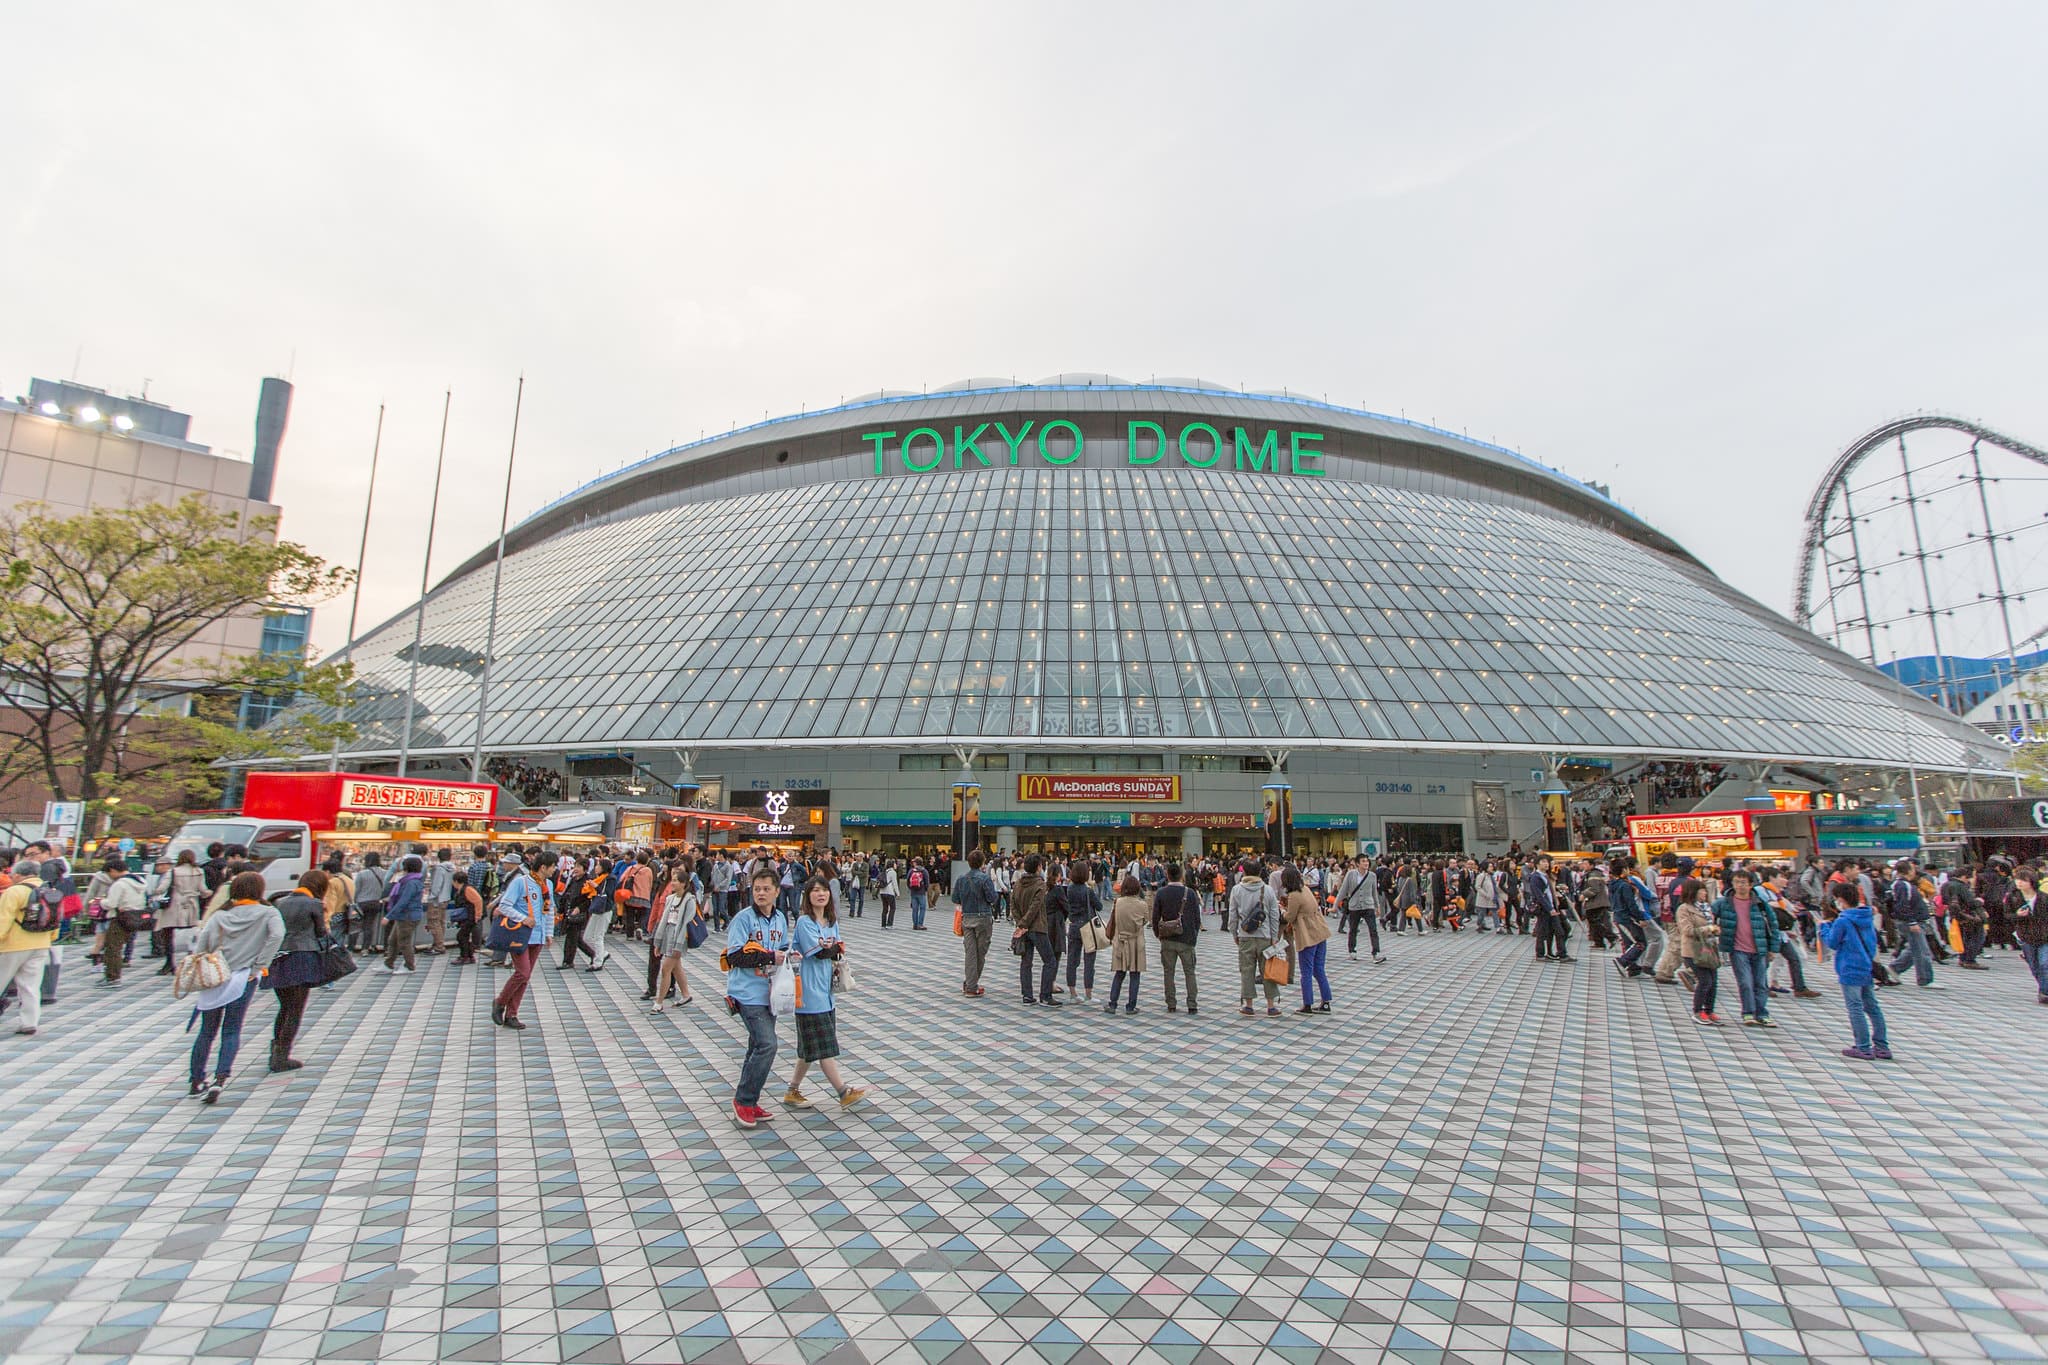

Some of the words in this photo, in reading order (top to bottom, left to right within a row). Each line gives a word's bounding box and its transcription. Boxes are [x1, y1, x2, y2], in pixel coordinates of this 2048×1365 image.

[862, 420, 1084, 474] TOKYO
[1128, 420, 1326, 476] DOME
[1053, 782, 1121, 792] McDonald's
[1123, 782, 1172, 792] SUNDAY
[352, 784, 448, 807] BASEBALL
[1158, 814, 1249, 825] シーズンシート専用ゲート
[1637, 820, 1703, 835] BASEBALL
